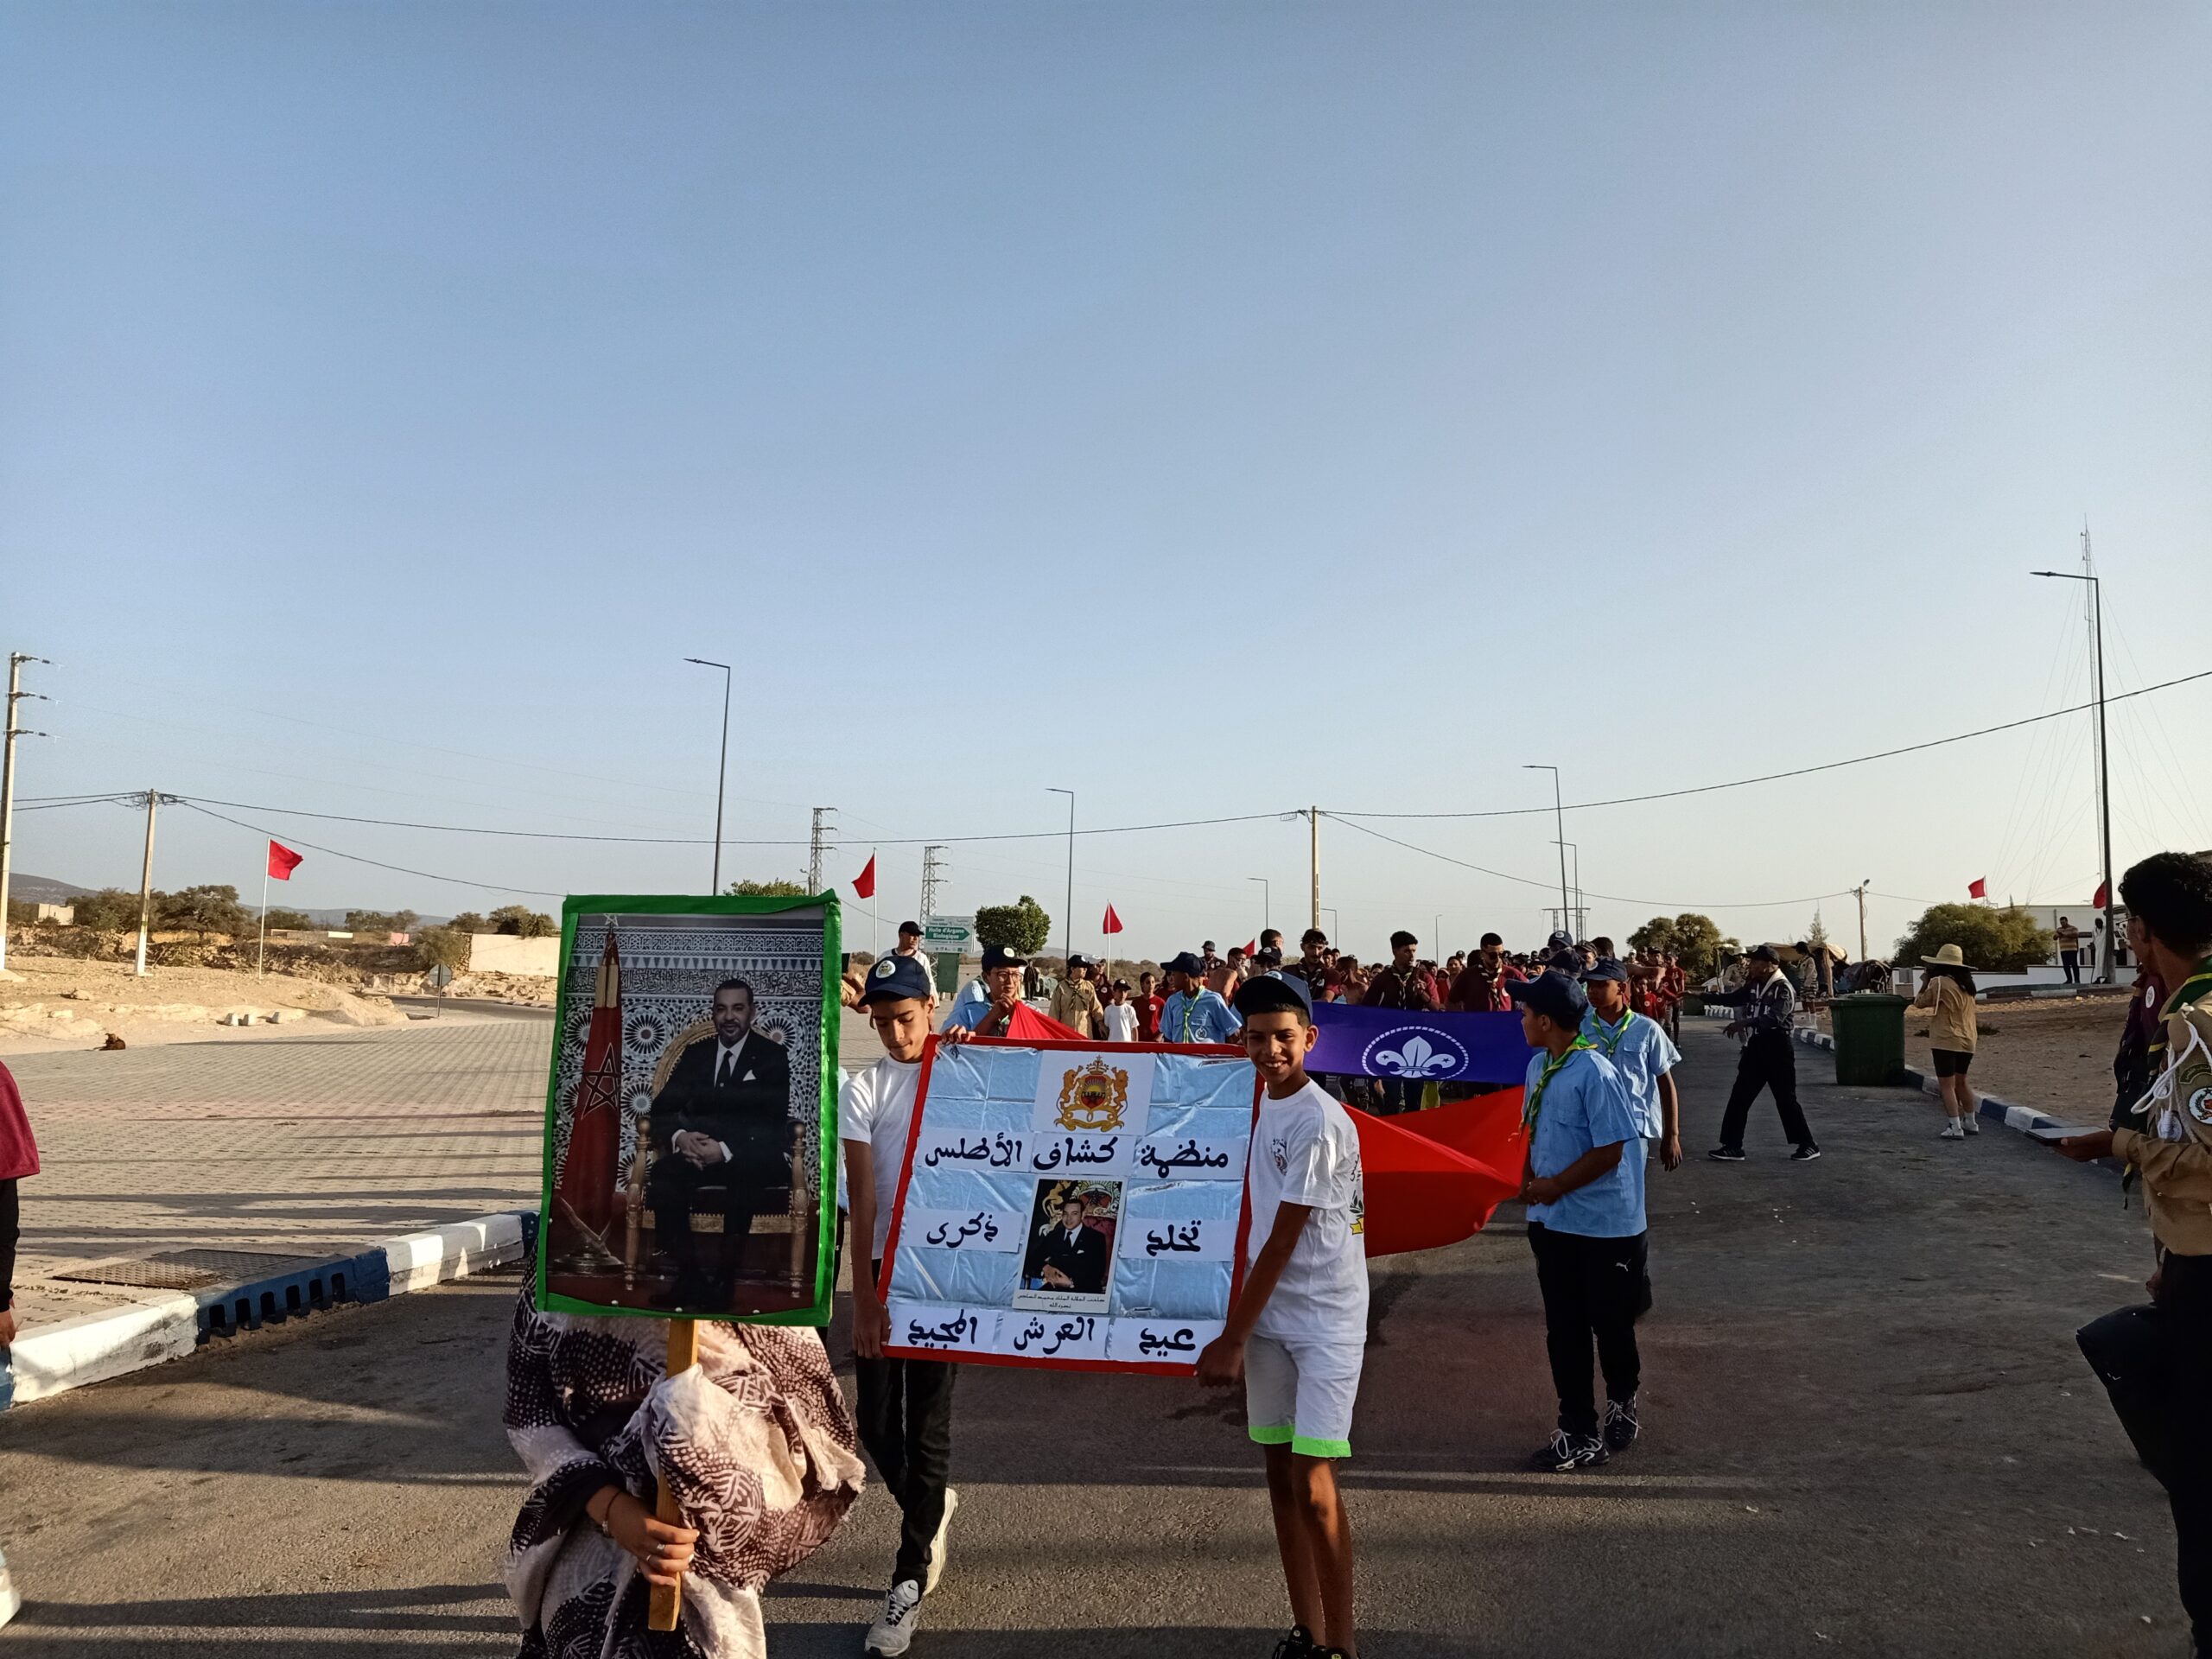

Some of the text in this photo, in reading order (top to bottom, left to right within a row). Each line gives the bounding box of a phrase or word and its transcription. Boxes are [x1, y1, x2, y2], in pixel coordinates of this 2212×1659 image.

[925, 1132, 1023, 1167] الأطلس
[1032, 1135, 1119, 1171] كشاف
[1140, 1139, 1230, 1179] منظمة
[925, 1211, 1202, 1256] تخلد ذكرى
[906, 1308, 1197, 1357] عيد العرش المجيد
